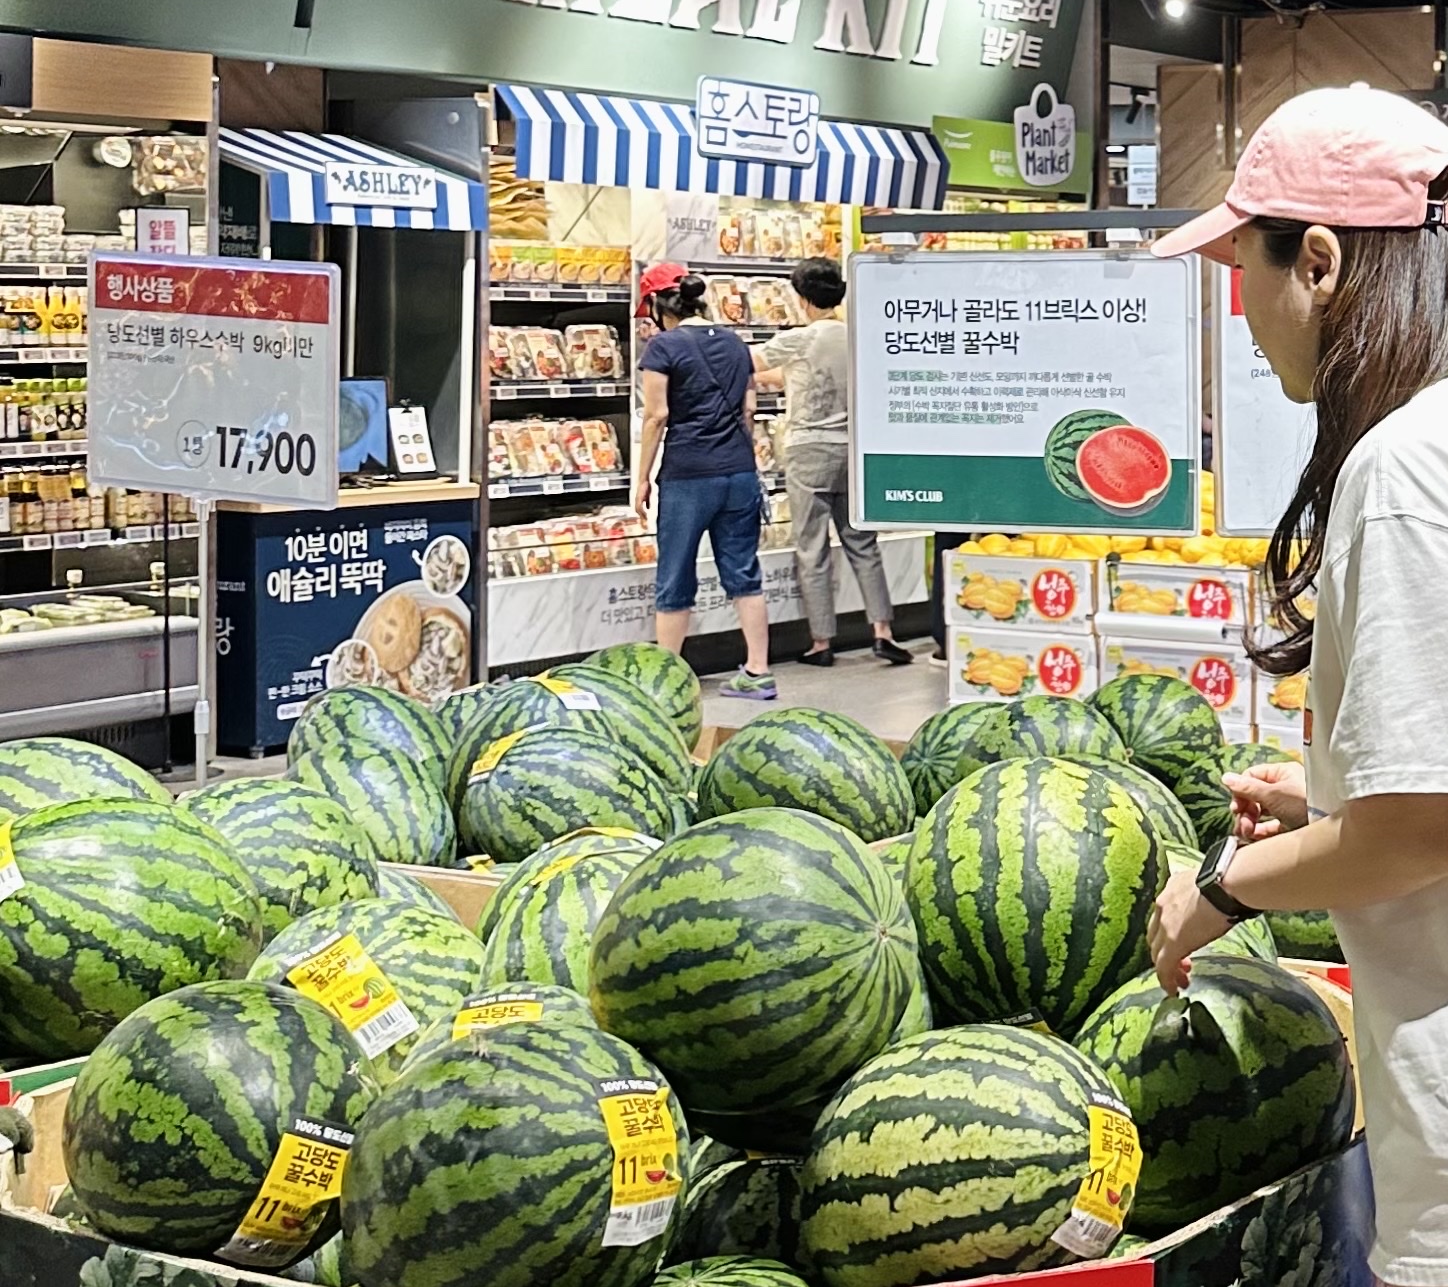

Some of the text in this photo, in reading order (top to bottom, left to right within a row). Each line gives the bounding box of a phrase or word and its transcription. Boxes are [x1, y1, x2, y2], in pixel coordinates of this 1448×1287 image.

[981, 27, 1043, 68] 밀키트
[700, 81, 819, 155] 홈스토랑
[1022, 121, 1057, 148] Plant
[1025, 149, 1070, 176] Market
[343, 170, 421, 195] ASHLEY
[107, 274, 174, 304] 행사상품
[884, 298, 1147, 323] 아무거나 골라도 11브릭스 이상!
[108, 323, 165, 348] 당도선별
[170, 328, 244, 354] 하우스수박
[884, 330, 1020, 355] 당도선별 꿀수박
[216, 426, 316, 477] 17,900
[885, 490, 943, 503] KIM'S CLUB
[285, 534, 327, 562] 10분
[329, 529, 368, 560] 이면
[267, 559, 387, 603] 애슐리 뚝딱
[472, 1005, 525, 1019] 고당도
[601, 1080, 628, 1093] 100%
[295, 1118, 322, 1136] 100%
[292, 1142, 341, 1170] 고당도
[1102, 1132, 1134, 1161] 꿀수박
[284, 1163, 333, 1191] 꿀수박
[619, 1155, 637, 1185] 11
[255, 1196, 281, 1222] 11
